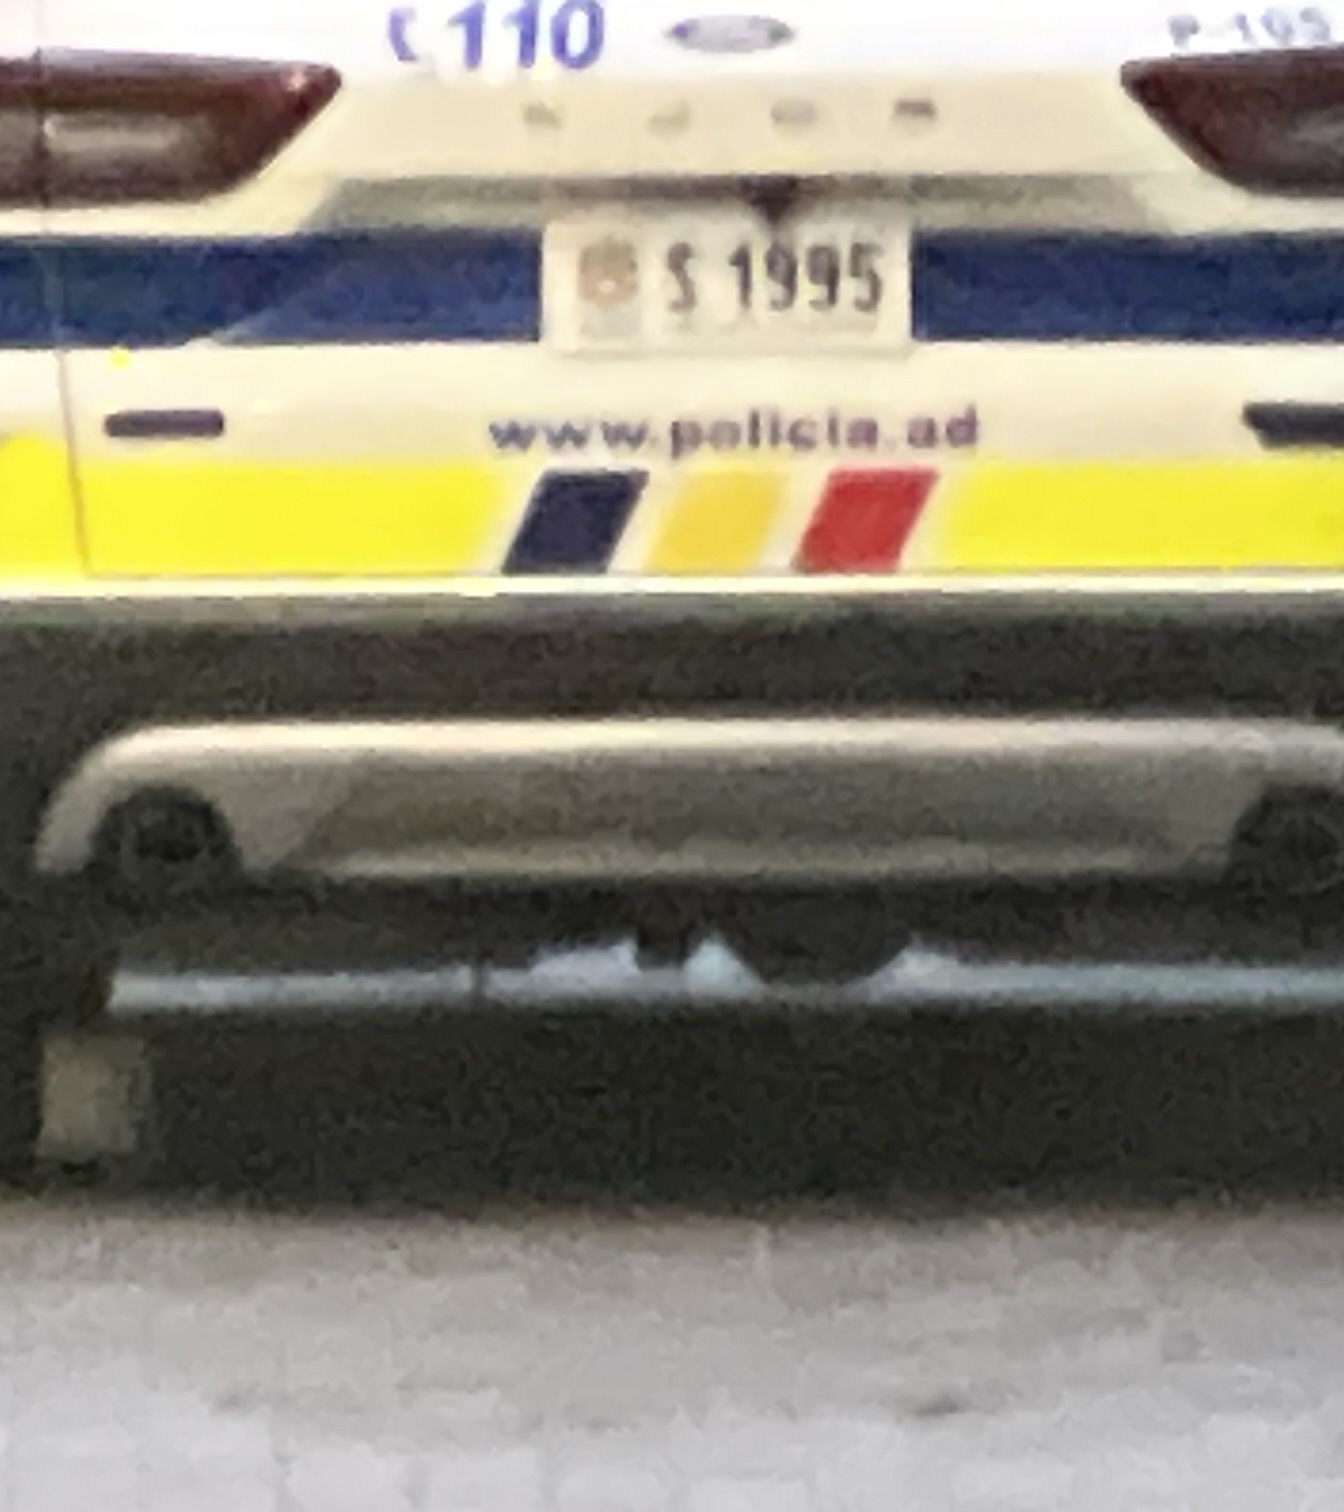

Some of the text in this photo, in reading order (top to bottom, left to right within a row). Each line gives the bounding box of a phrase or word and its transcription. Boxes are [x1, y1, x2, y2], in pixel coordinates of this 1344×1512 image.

[666, 241, 883, 313] S 1995
[488, 402, 980, 460] www.policia.ad
